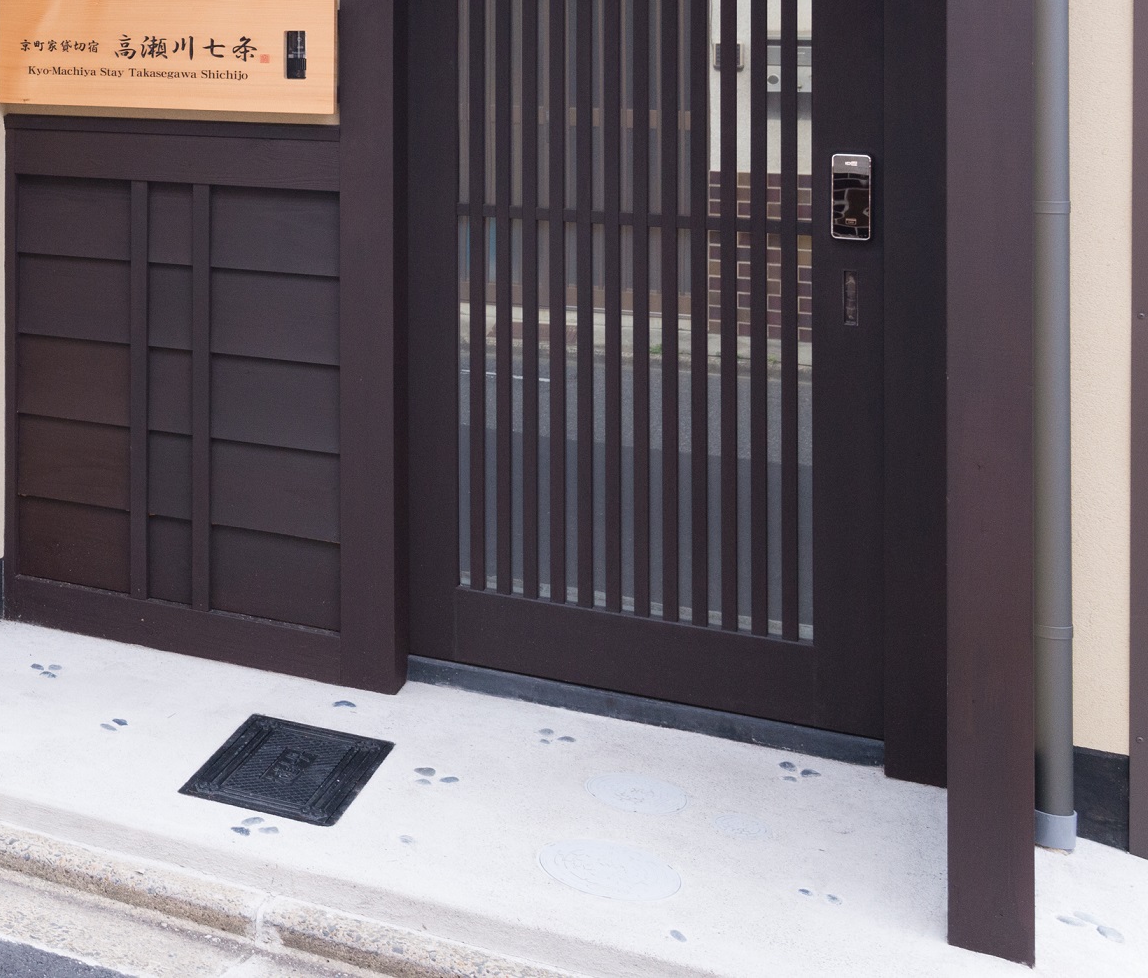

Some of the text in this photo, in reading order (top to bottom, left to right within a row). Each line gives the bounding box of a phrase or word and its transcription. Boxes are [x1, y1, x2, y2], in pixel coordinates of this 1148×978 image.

[20, 39, 99, 54] 京町家貸切宿
[114, 34, 257, 62] 高瀬川七条
[28, 65, 249, 82] Kyo-Machiya Stay Takasegawa Shichijo
